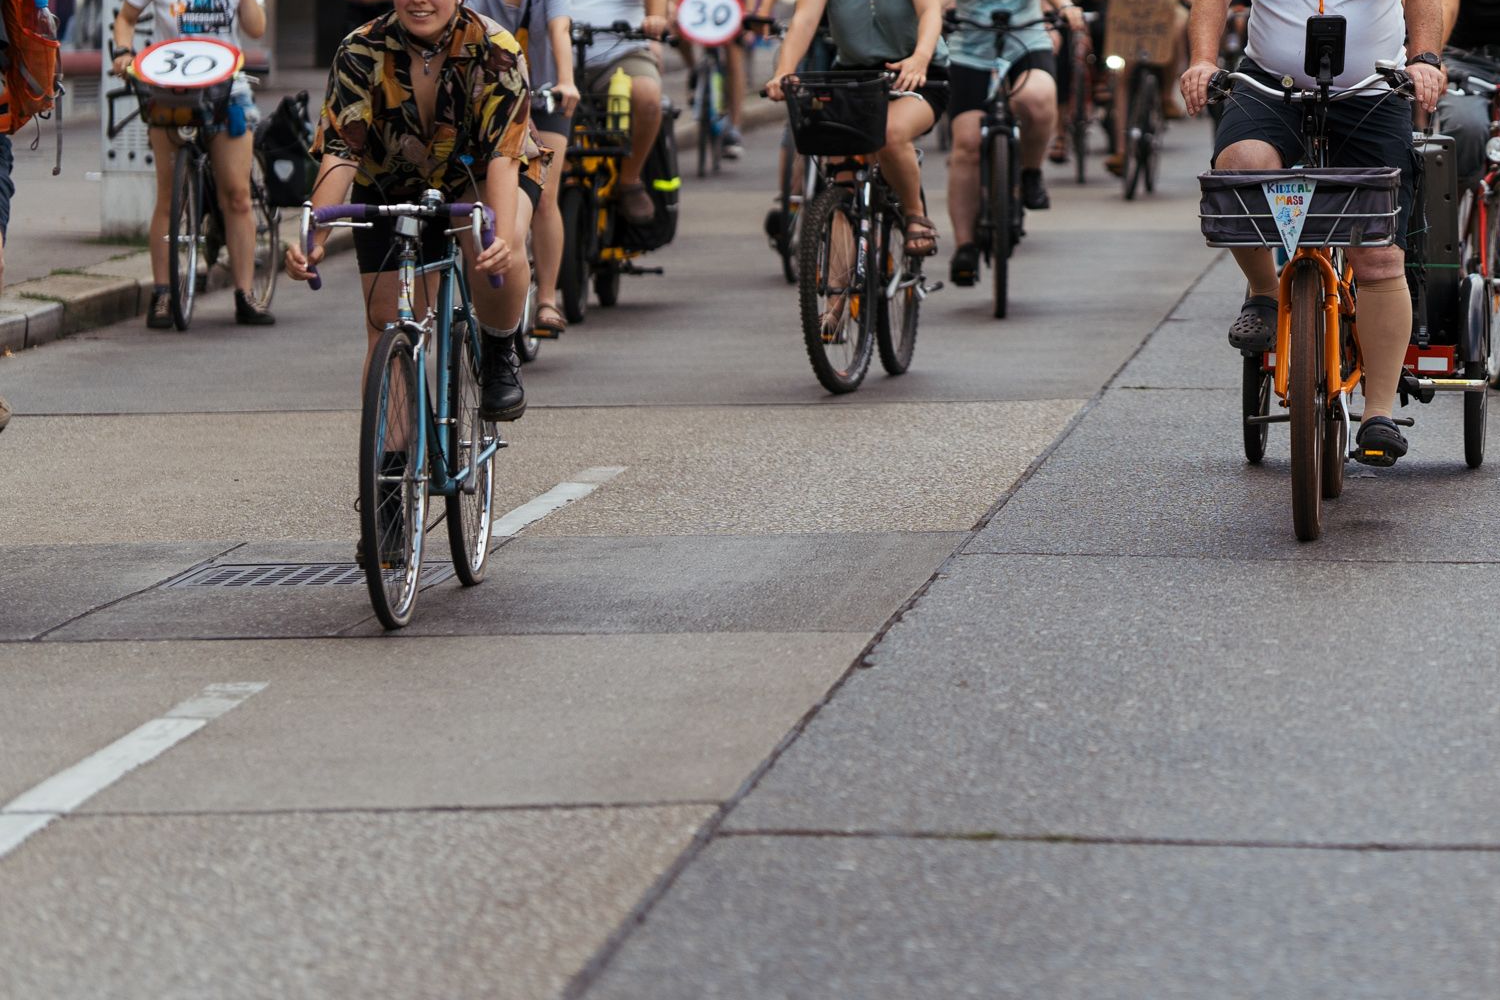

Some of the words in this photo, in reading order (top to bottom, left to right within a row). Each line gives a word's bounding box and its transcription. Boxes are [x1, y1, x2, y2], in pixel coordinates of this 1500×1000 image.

[690, 0, 732, 27] 30
[154, 49, 218, 77] 30
[1267, 183, 1311, 193] KIDICAL
[1276, 195, 1303, 205] MASS
